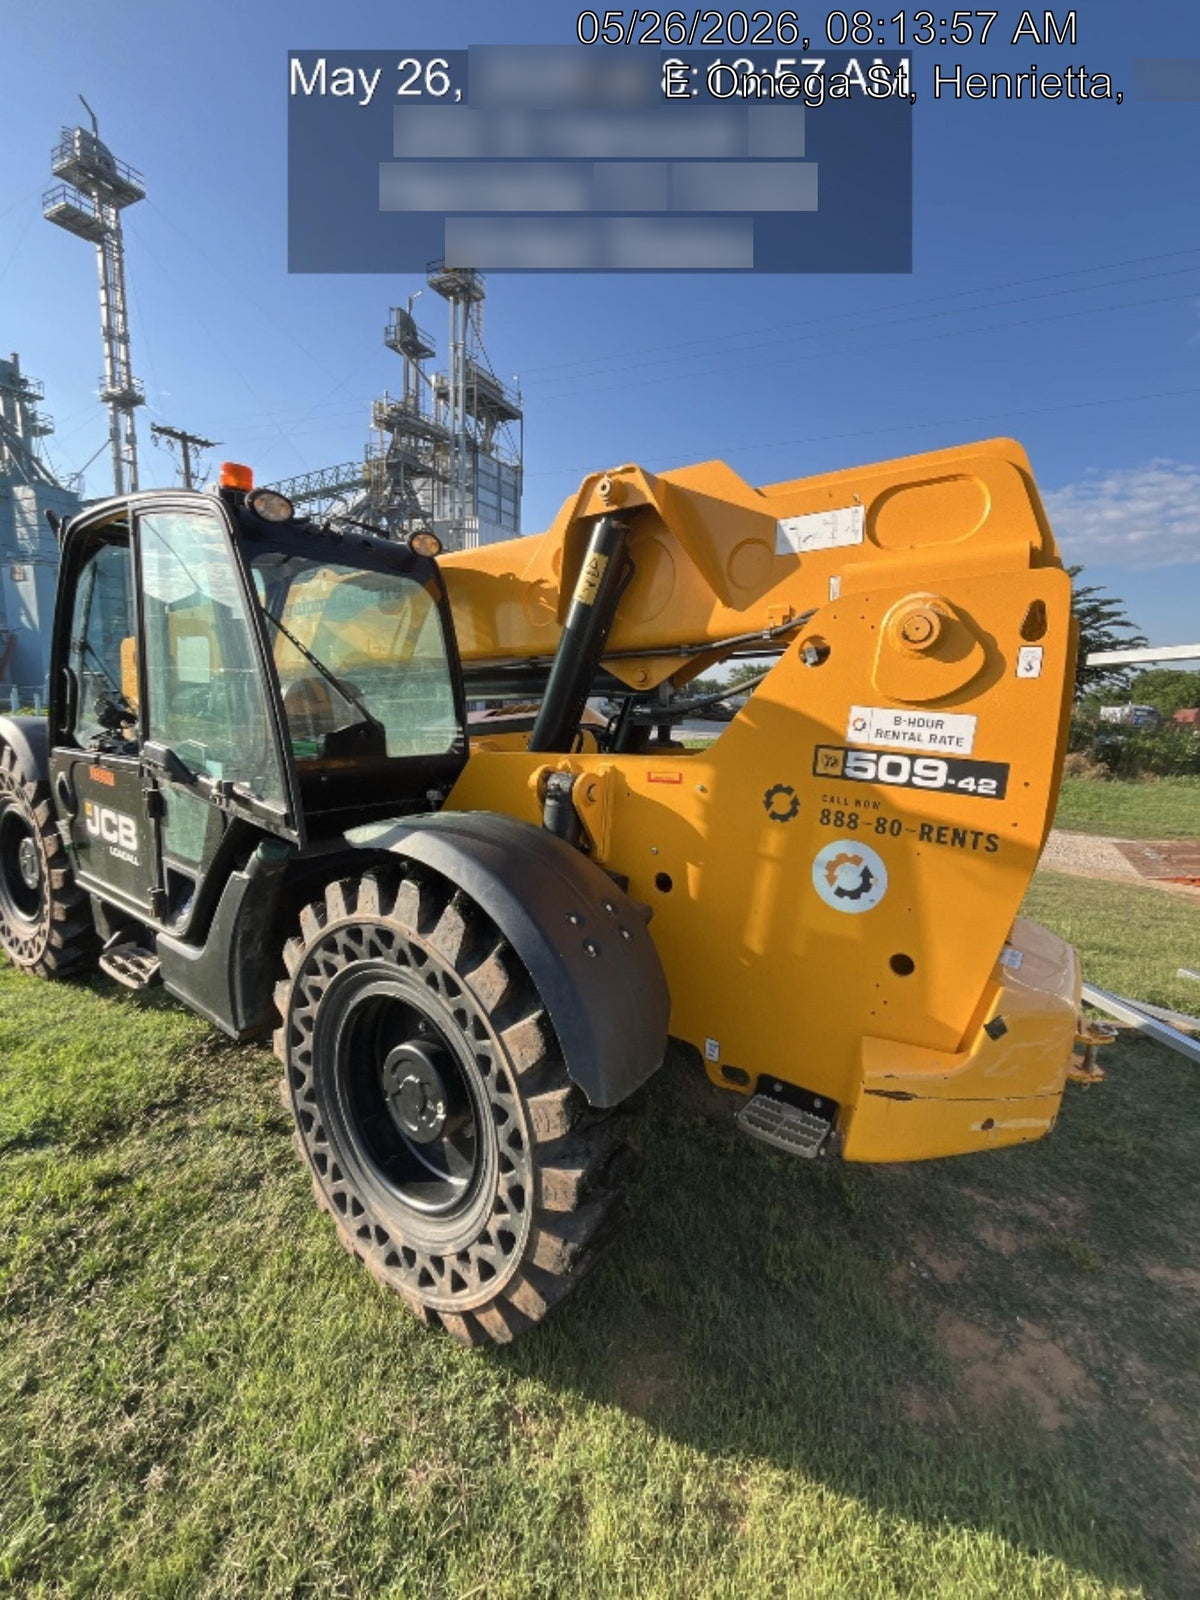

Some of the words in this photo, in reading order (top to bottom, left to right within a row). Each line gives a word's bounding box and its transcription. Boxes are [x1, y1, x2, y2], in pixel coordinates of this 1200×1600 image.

[874, 727, 923, 744] RENTAL
[928, 733, 964, 748] RATE
[844, 750, 998, 796] 509-42
[822, 794, 849, 807] CALL
[854, 799, 881, 811] NOW
[85, 802, 138, 852] JCB
[819, 808, 1000, 854] 888-80-RENTS
